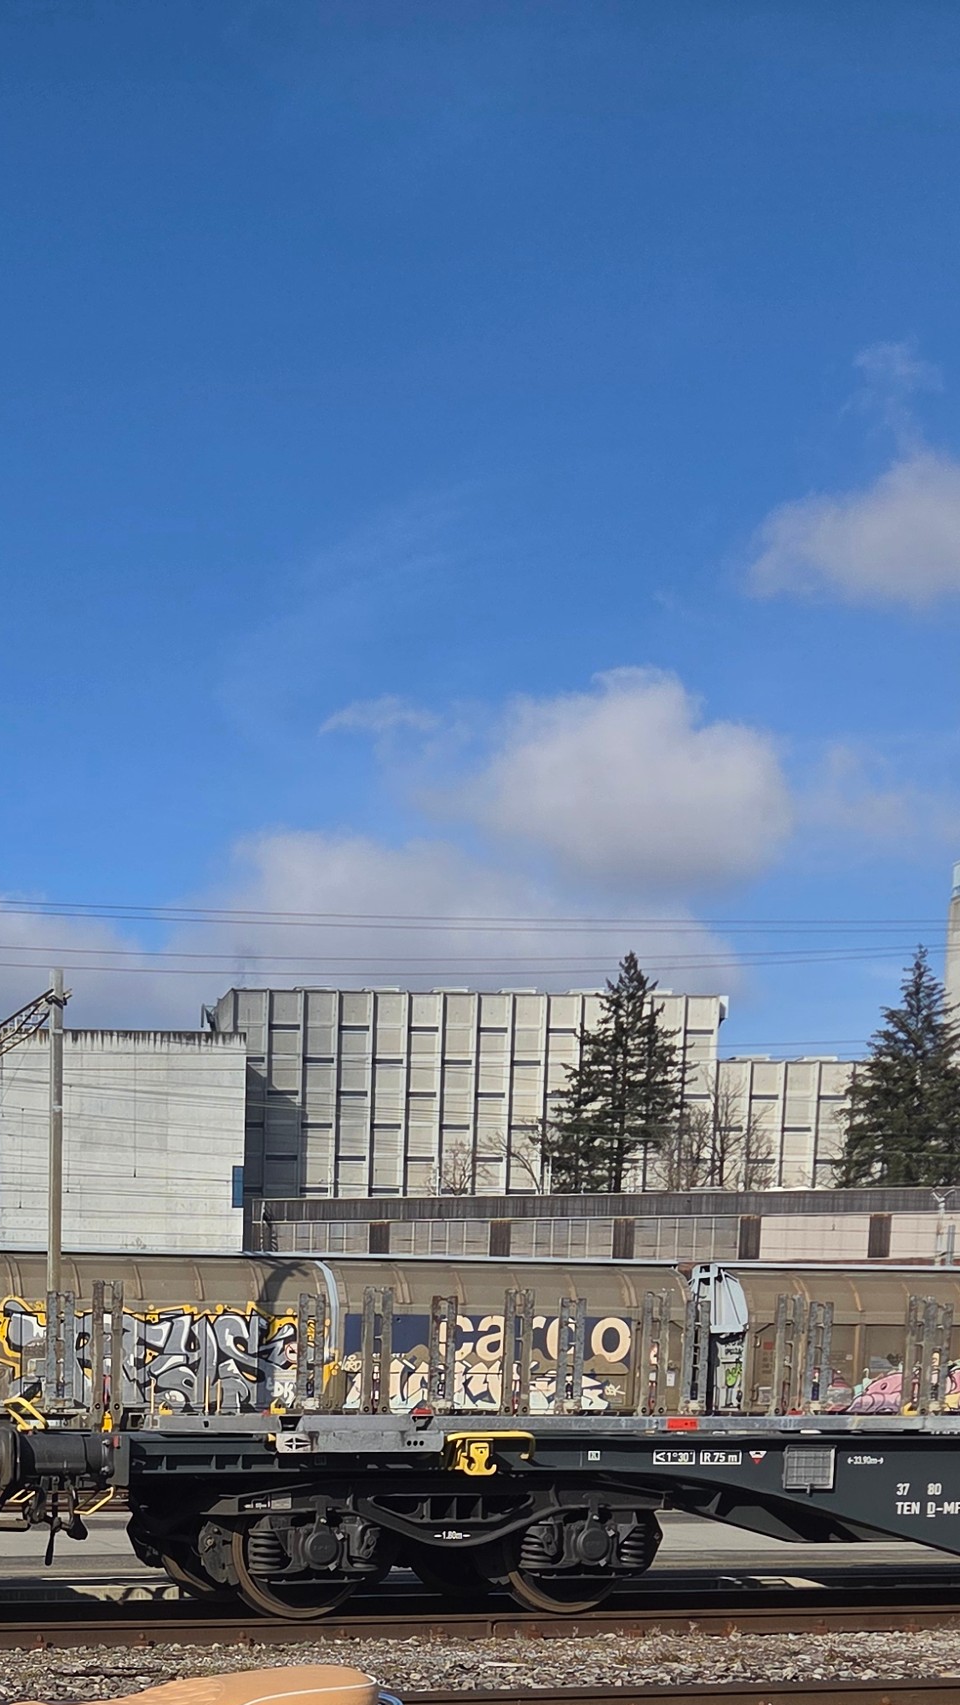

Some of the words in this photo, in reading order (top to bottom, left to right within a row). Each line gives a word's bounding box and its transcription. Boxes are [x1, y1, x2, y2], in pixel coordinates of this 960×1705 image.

[703, 1452, 711, 1463] R
[713, 1452, 726, 1463] 75
[727, 1454, 738, 1463] m
[896, 1482, 910, 1496] 37
[927, 1482, 942, 1496] 80
[895, 1501, 921, 1515] TEN
